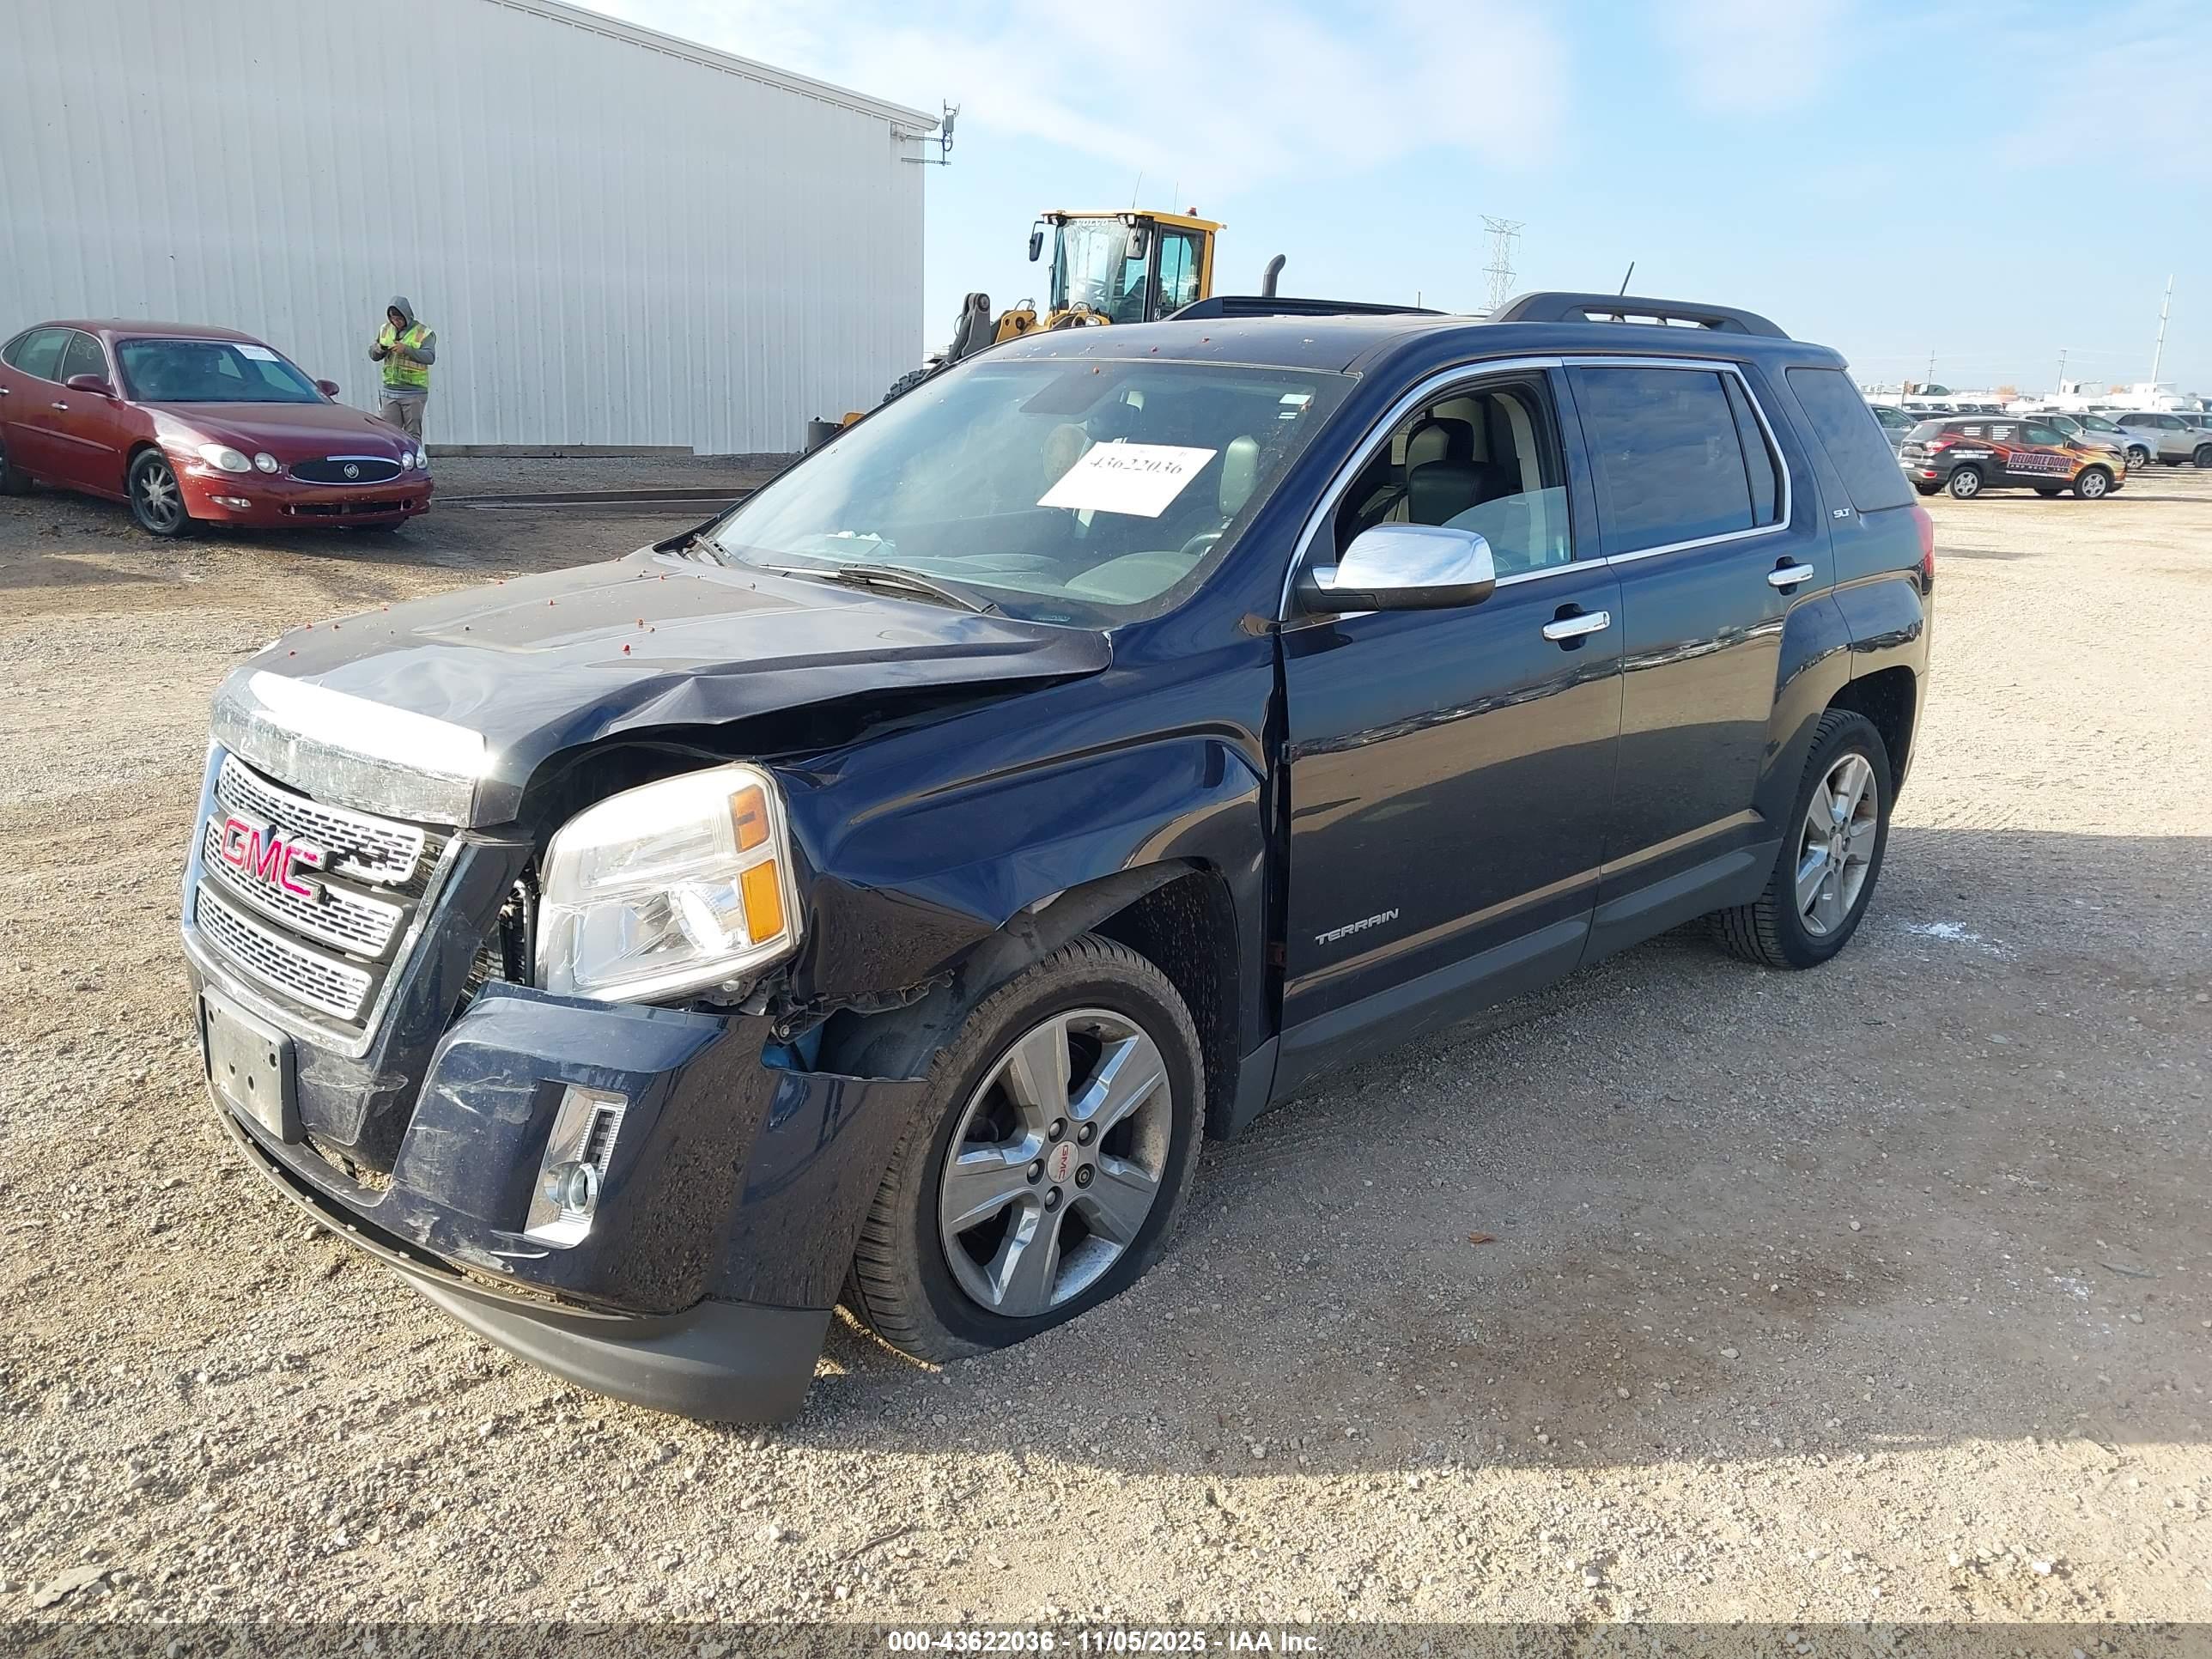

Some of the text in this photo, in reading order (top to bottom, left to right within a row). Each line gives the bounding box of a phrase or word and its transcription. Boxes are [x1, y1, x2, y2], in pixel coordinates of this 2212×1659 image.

[2010, 453, 2071, 467] RELIABLE DOOR
[1832, 507, 1850, 519] SLT
[221, 815, 325, 901] GMC
[1315, 908, 1399, 945] TERRAIN
[1058, 1144, 1069, 1181] GMC
